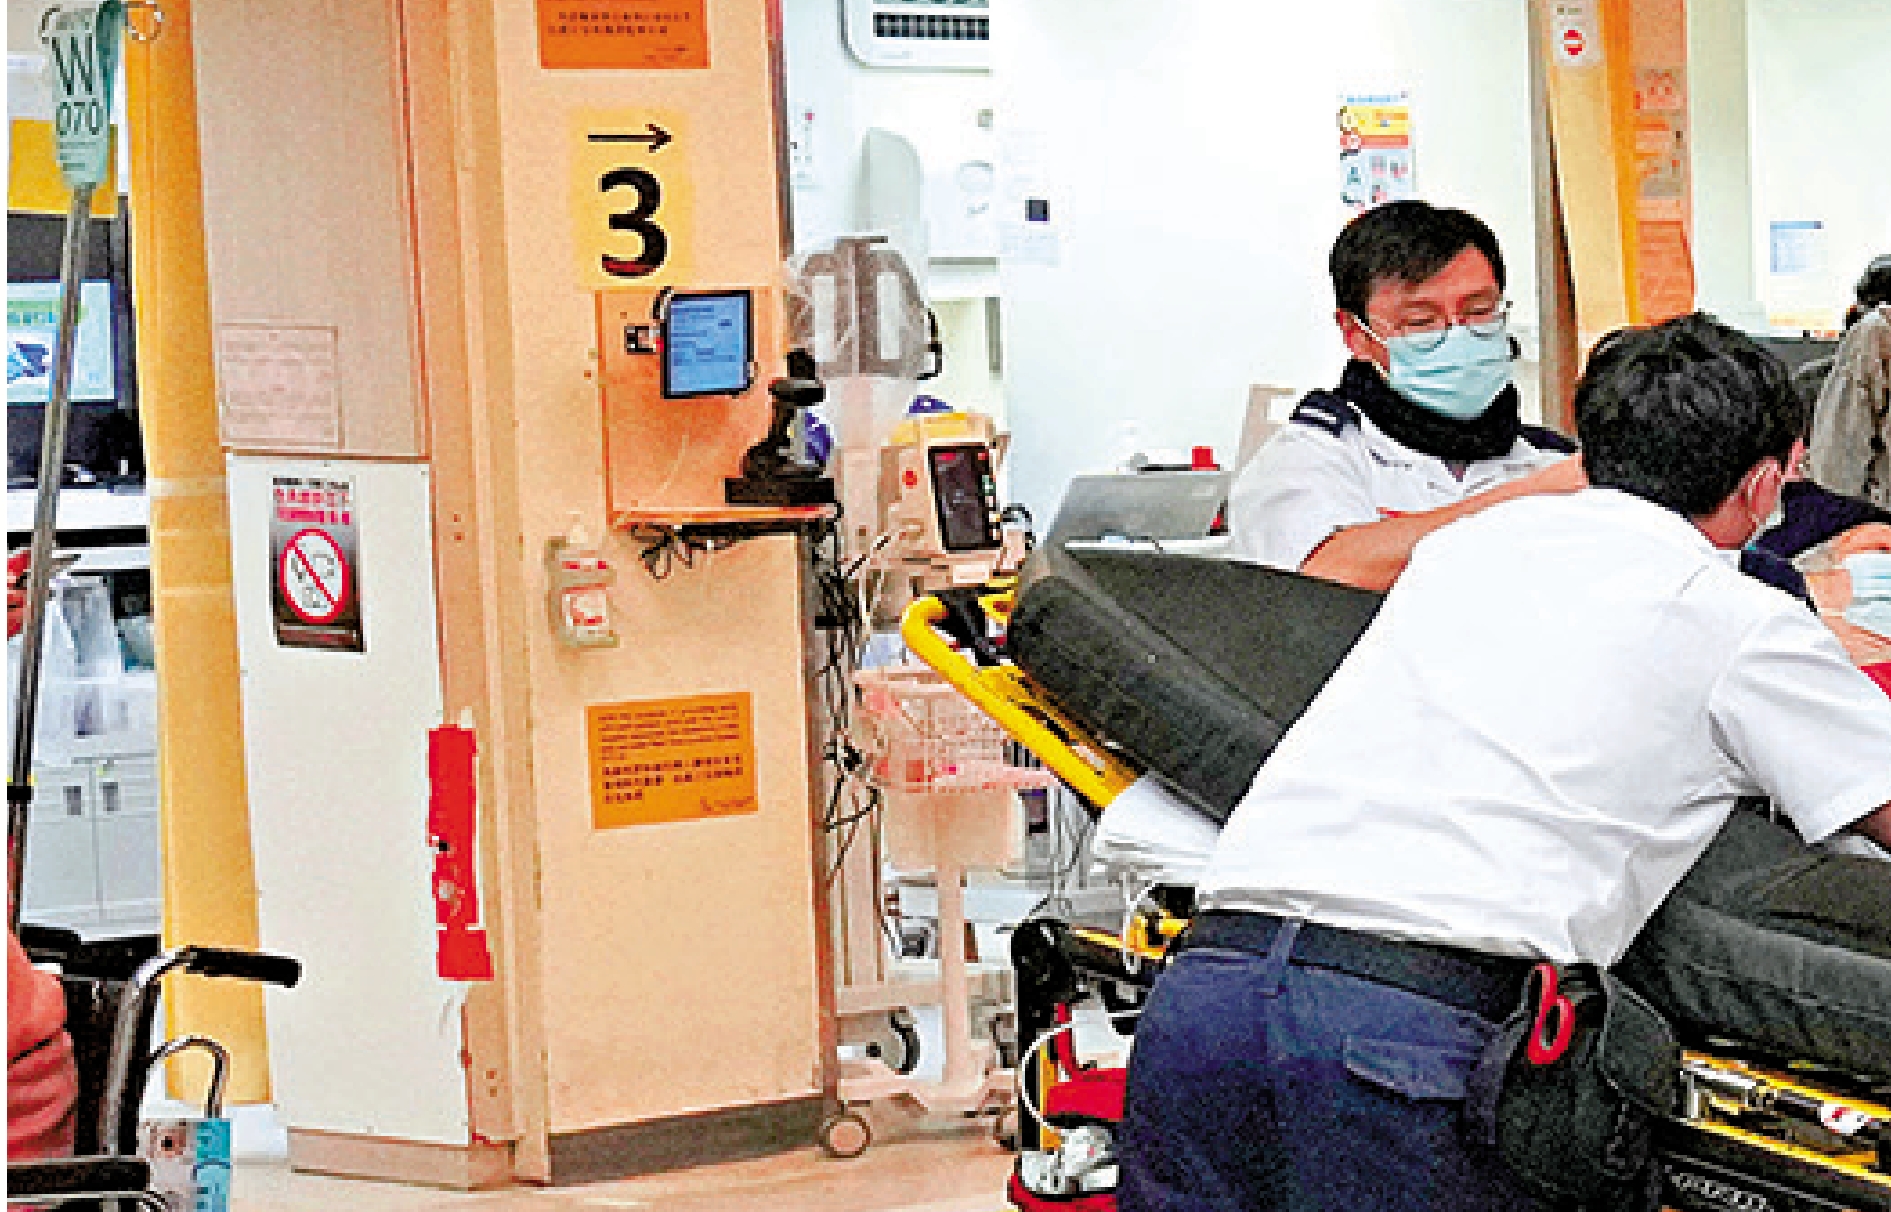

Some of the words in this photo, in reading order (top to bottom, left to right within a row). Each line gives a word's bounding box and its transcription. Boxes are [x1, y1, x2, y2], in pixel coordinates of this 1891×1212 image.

[51, 36, 93, 95] W
[55, 99, 104, 135] 070
[600, 166, 668, 277] 3
